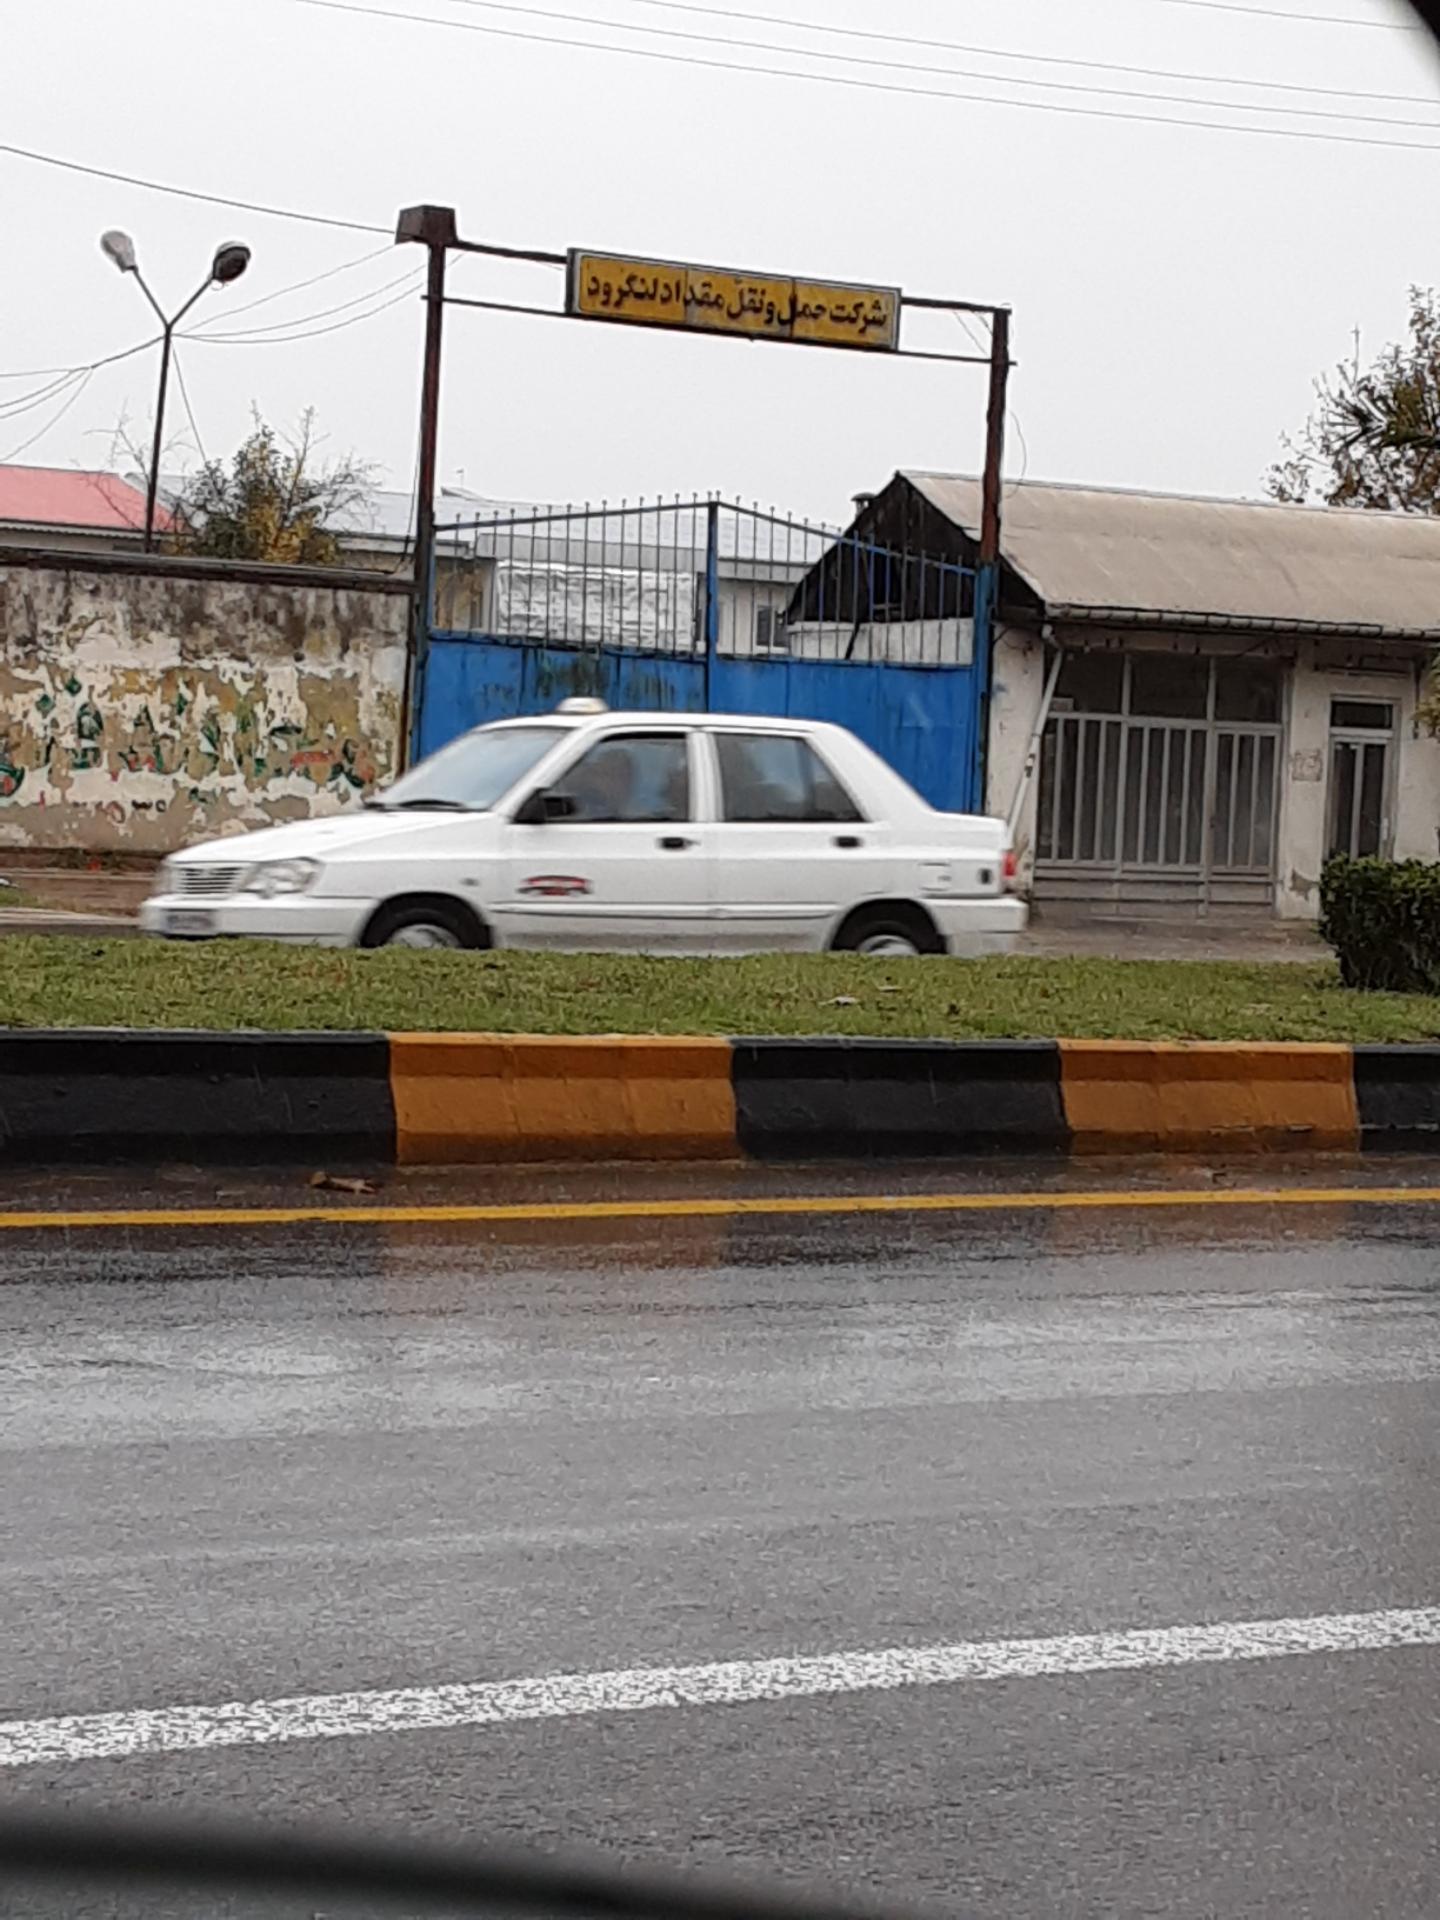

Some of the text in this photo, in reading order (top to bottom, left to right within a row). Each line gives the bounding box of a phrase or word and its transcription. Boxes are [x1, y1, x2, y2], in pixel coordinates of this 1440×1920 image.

[587, 272, 887, 334] شرکت حمل و نقل مقداد لنگرود
